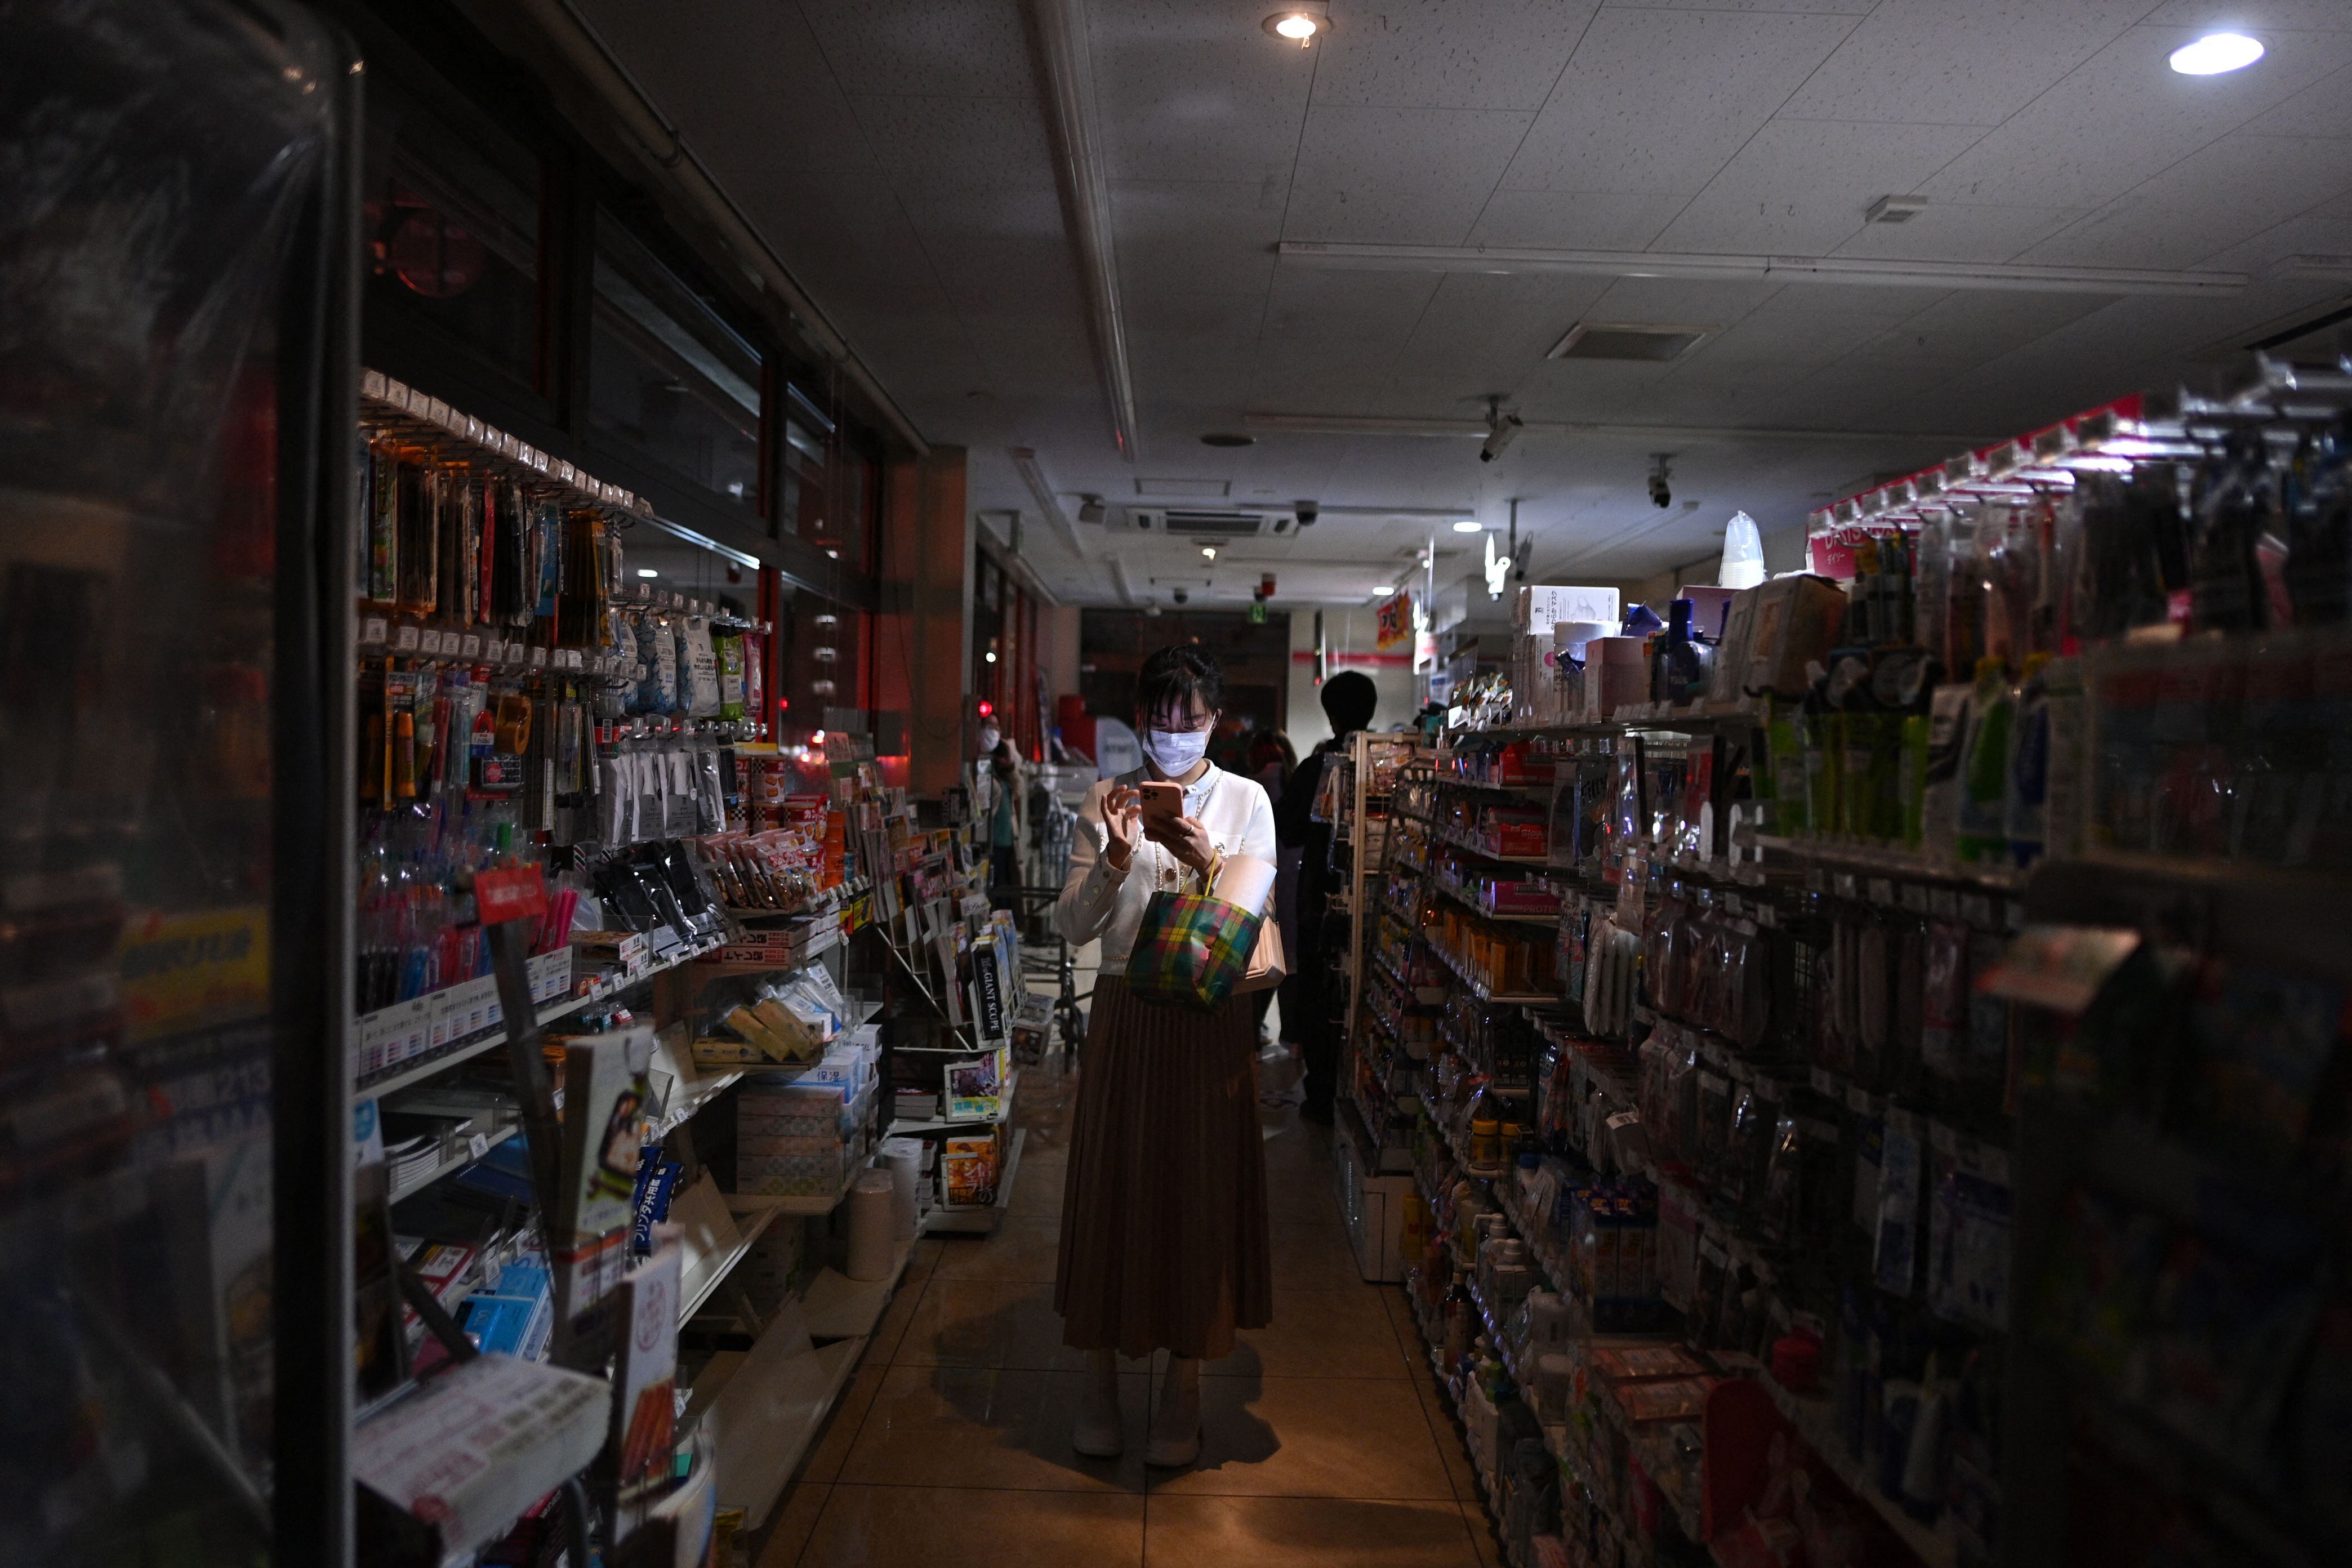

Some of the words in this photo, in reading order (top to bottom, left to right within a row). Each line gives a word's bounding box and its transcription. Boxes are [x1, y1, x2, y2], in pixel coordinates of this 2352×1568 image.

[984, 972, 996, 1001] GIANT
[987, 1002, 1000, 1032] SCOPE
[817, 1071, 841, 1082] 保湿
